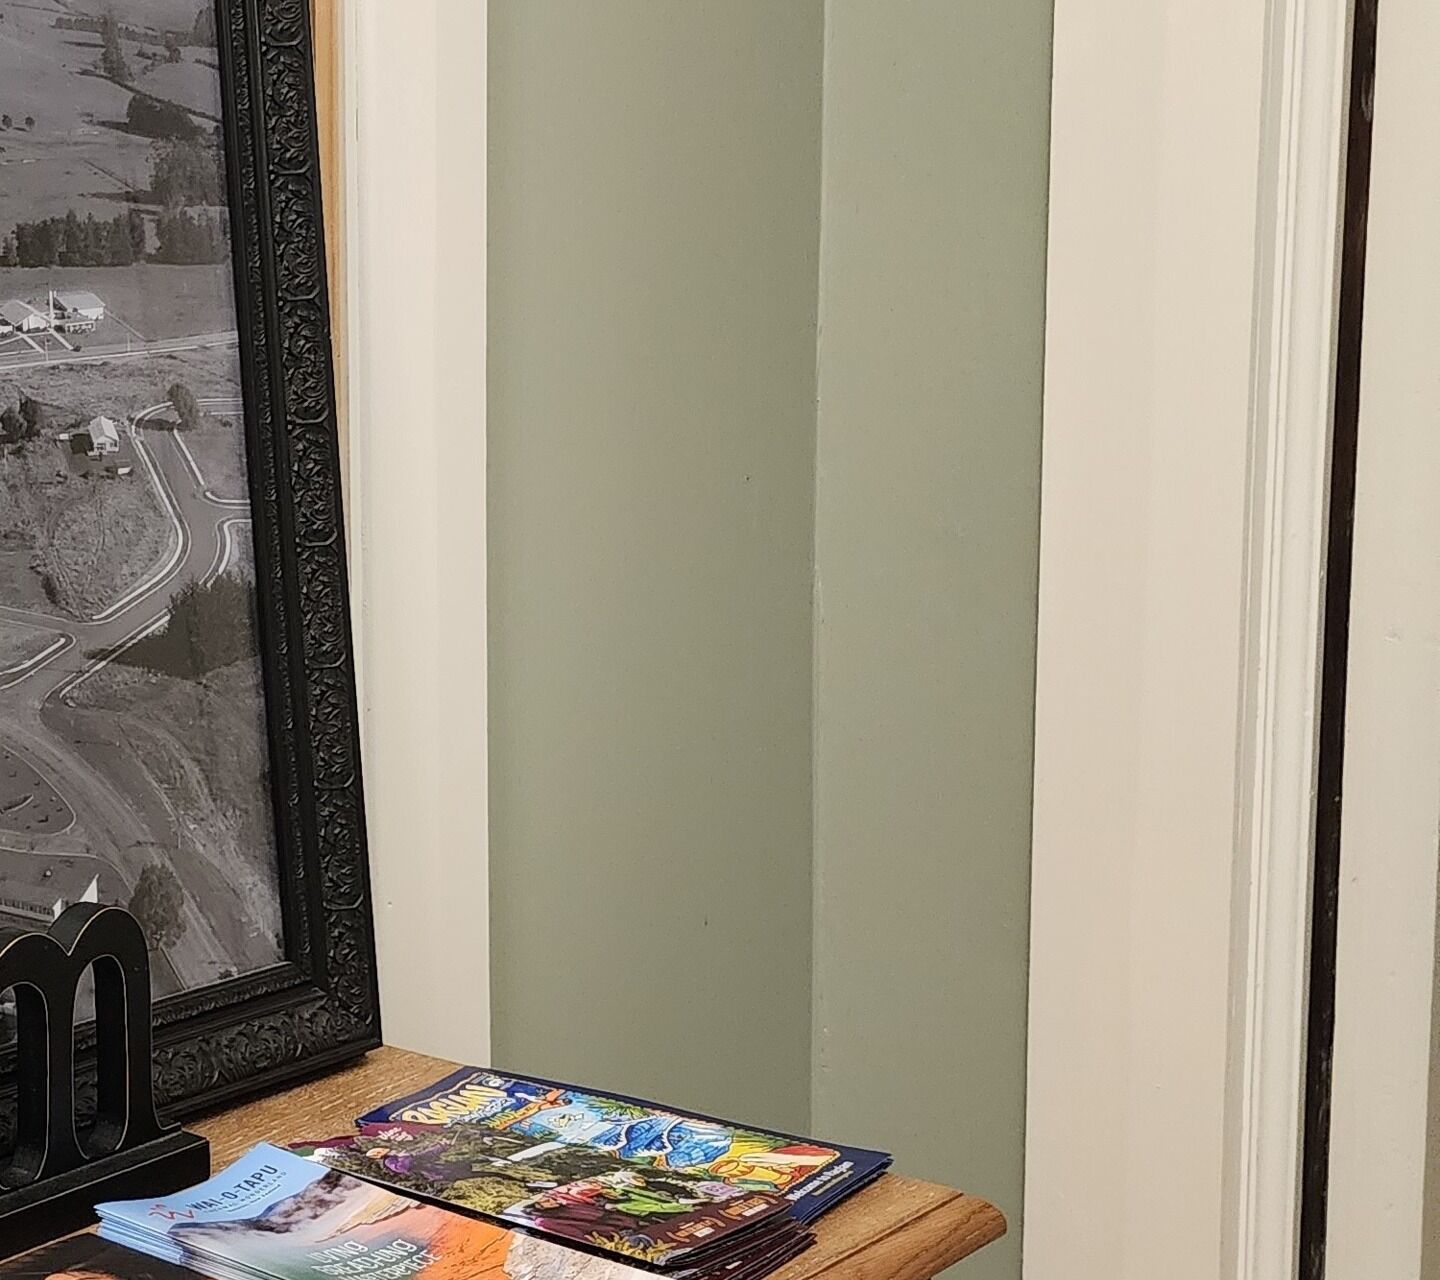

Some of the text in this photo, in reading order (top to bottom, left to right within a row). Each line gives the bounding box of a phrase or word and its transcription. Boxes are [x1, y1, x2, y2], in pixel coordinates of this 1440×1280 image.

[401, 1084, 508, 1124] RAGLAN
[186, 1165, 279, 1212] WAI-O-TAPU
[307, 1240, 368, 1263] LIVING
[312, 1239, 416, 1275] BREATHING
